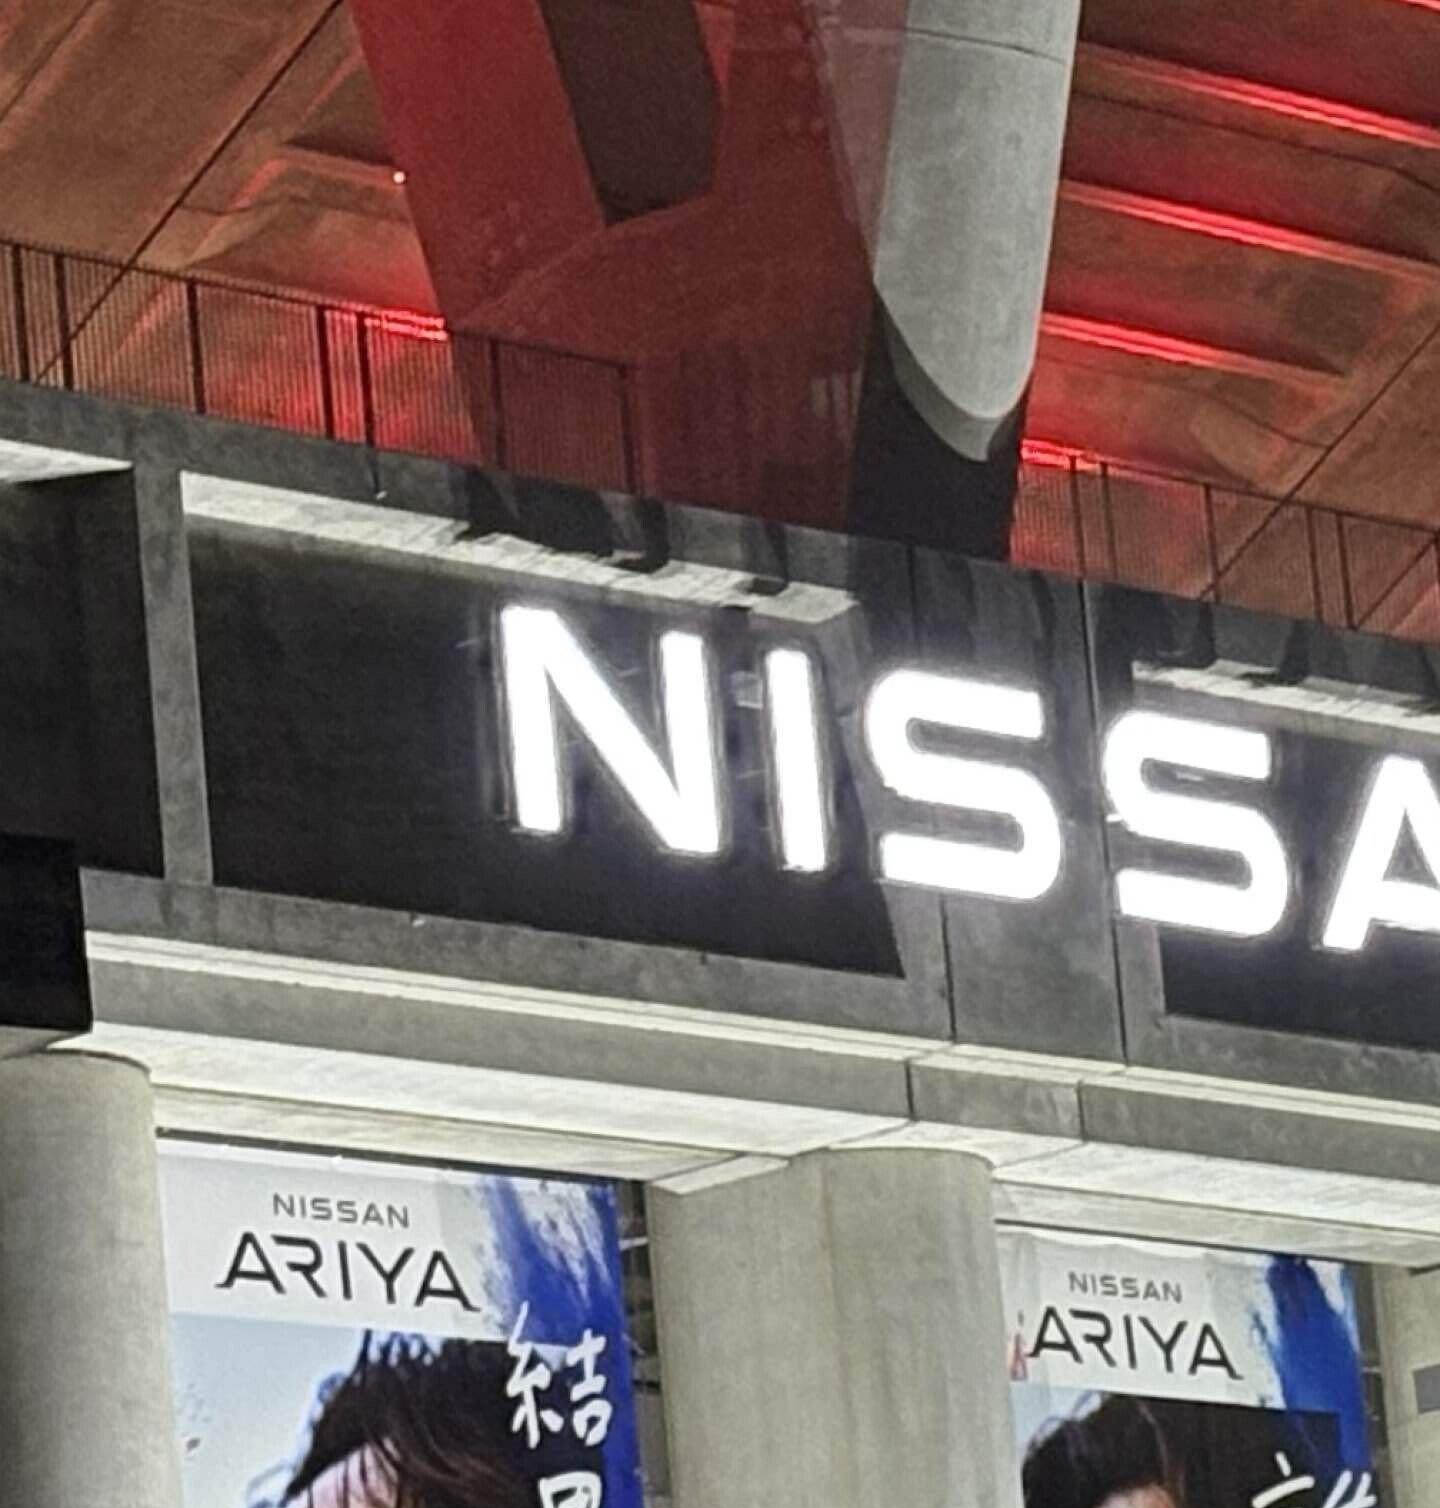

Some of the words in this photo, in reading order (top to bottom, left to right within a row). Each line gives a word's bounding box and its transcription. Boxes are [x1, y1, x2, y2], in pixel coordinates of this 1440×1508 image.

[273, 1193, 409, 1228] NISSAN
[216, 1232, 481, 1313] ARIYA
[1069, 1271, 1182, 1303] NISSAN
[1029, 1306, 1244, 1381] ARIYA
